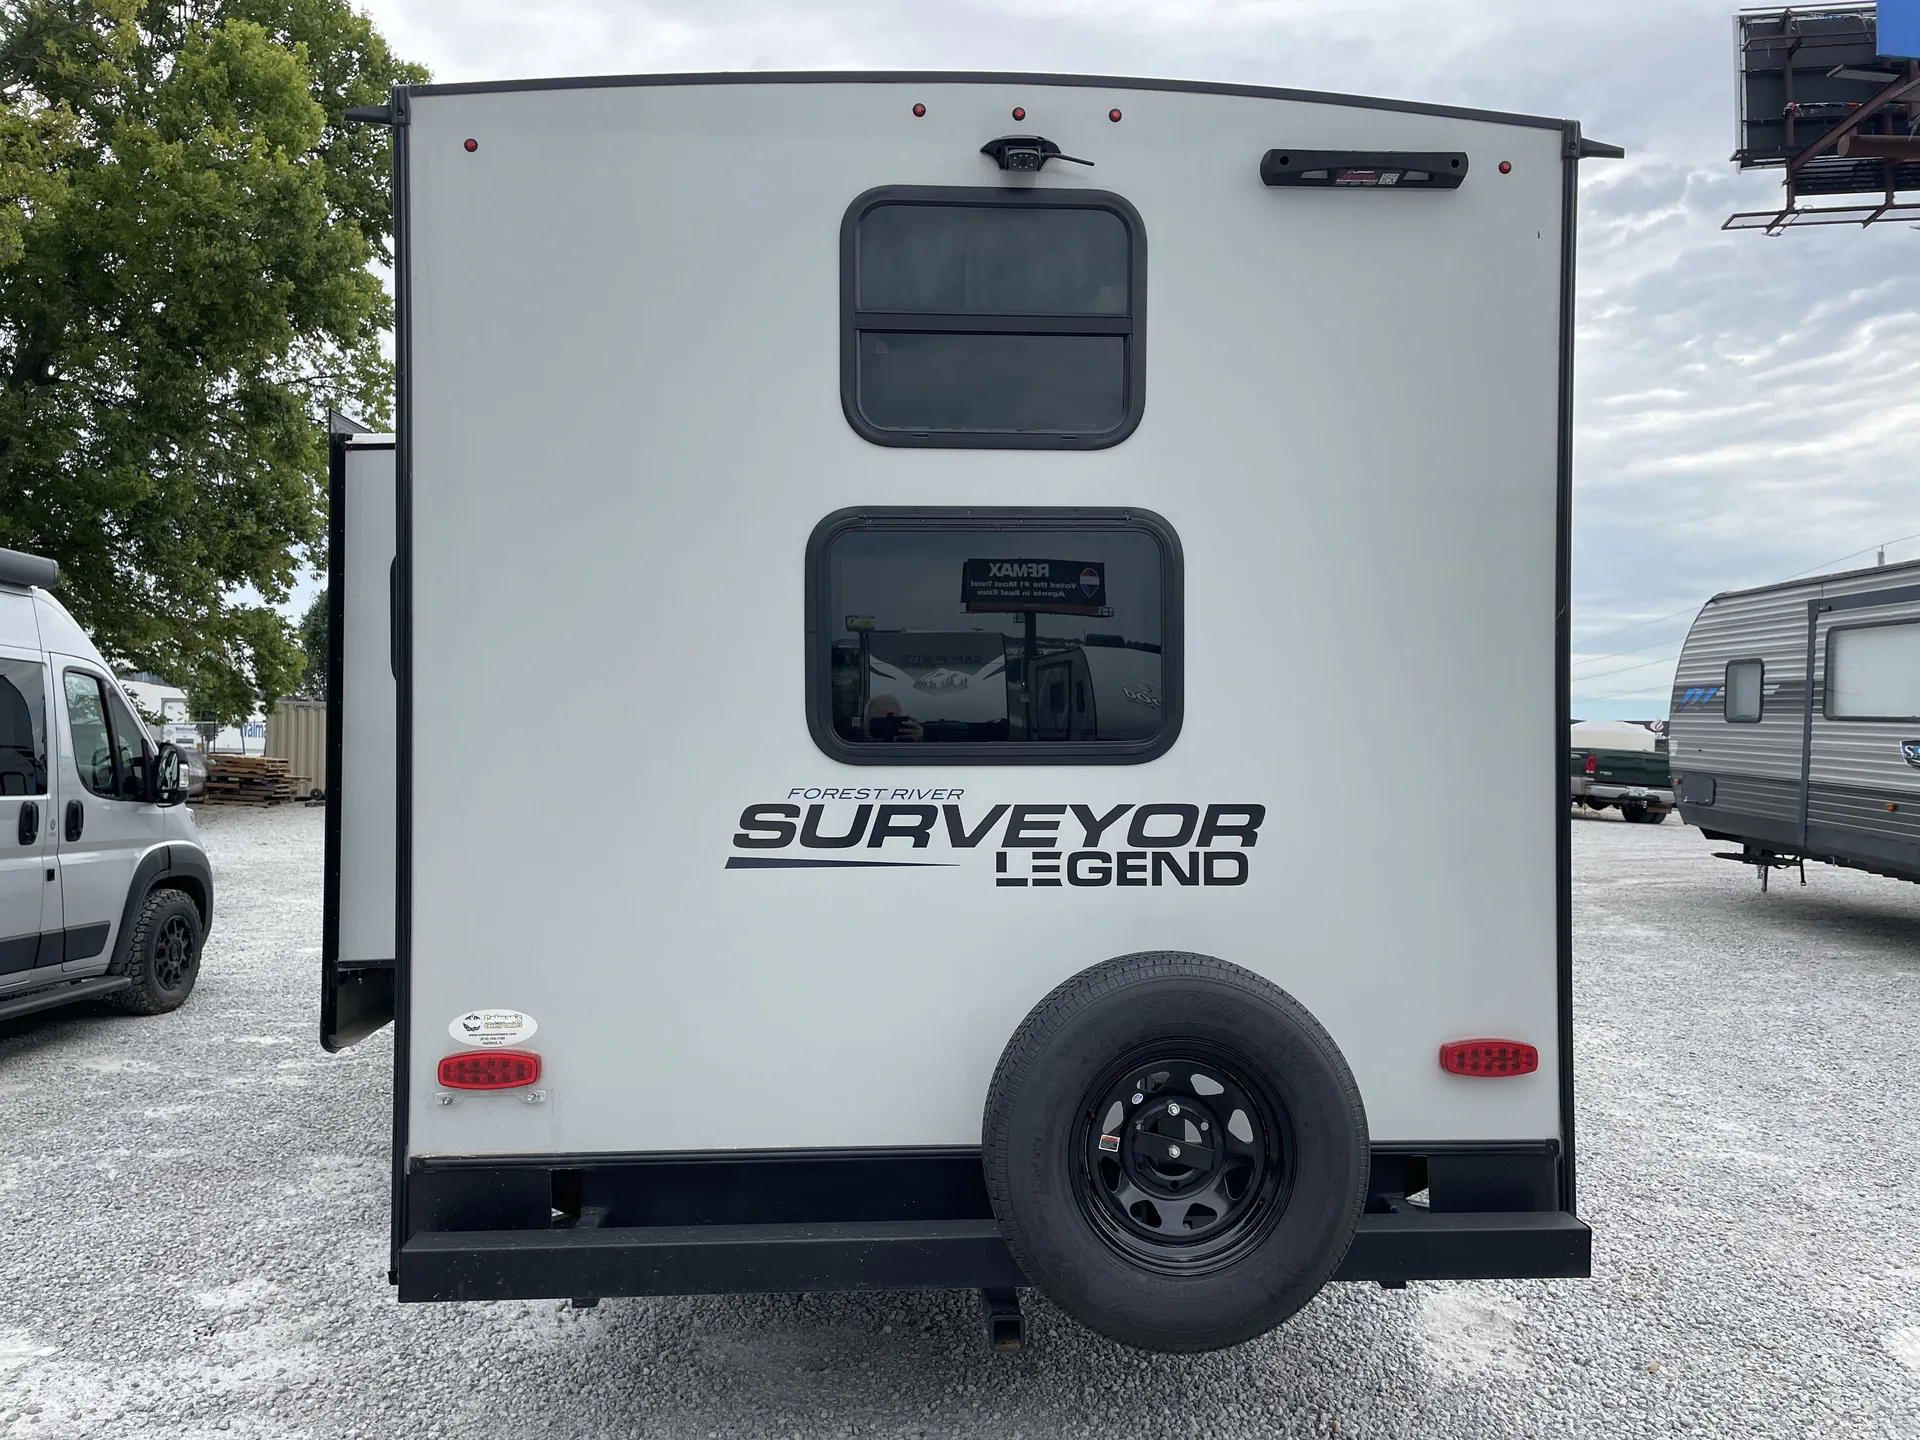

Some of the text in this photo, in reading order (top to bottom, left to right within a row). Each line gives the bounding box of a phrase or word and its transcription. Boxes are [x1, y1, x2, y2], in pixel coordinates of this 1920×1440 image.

[787, 787, 965, 800] FOREST RIVER
[732, 803, 1267, 849] SURVEYOR
[995, 850, 1249, 887] LEGEND
